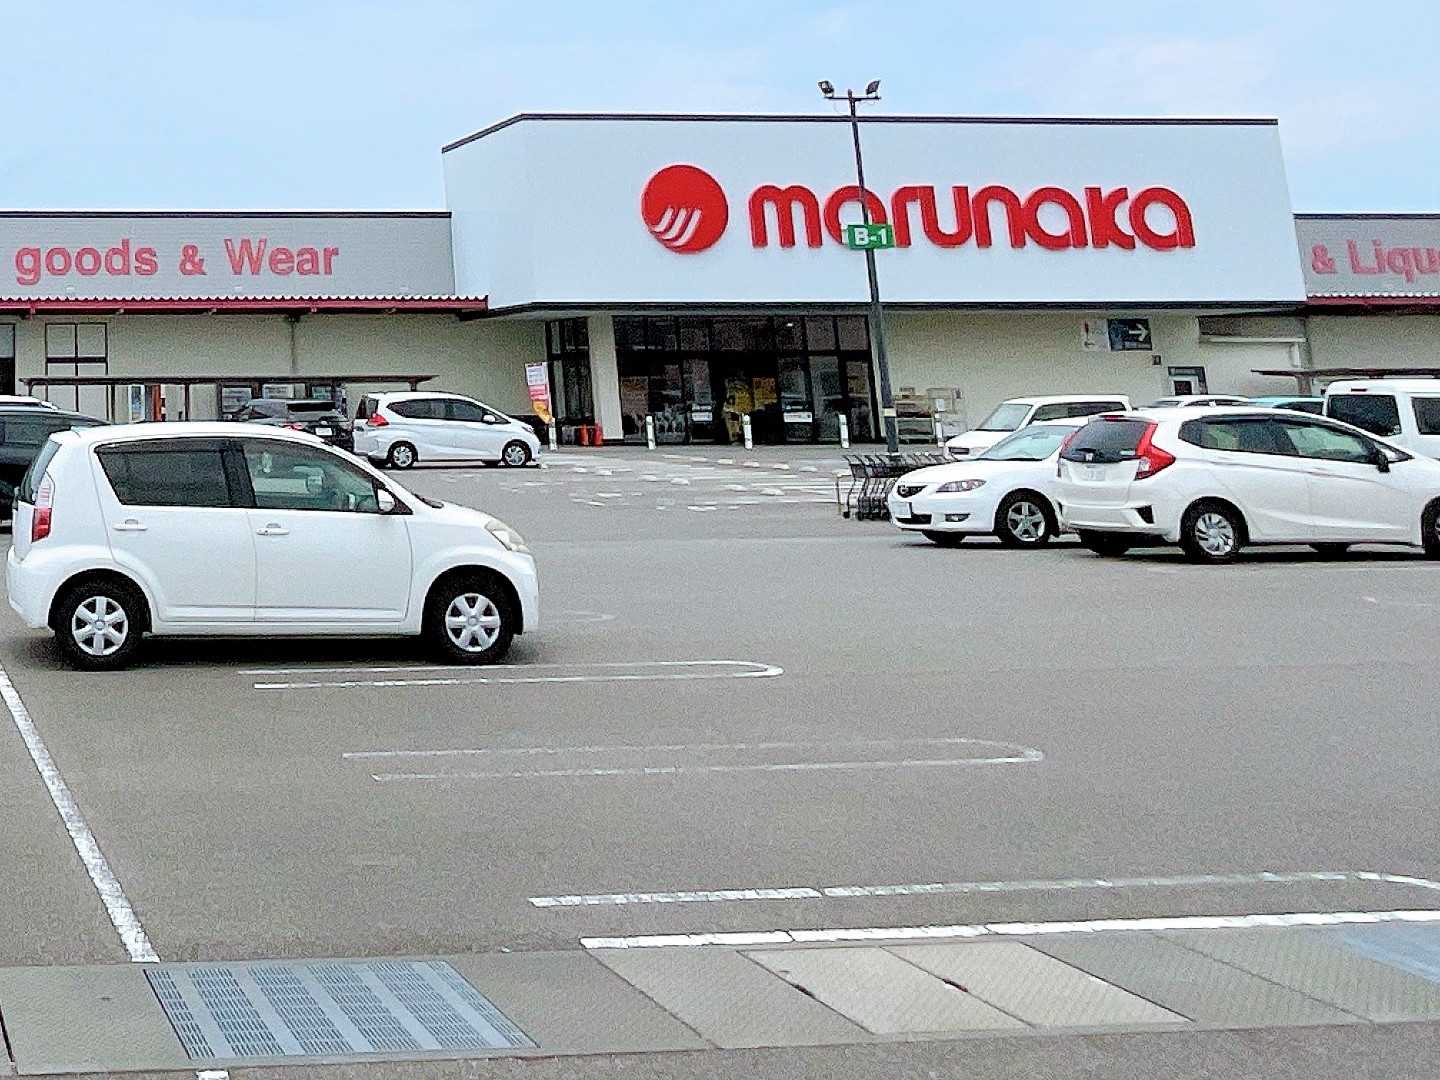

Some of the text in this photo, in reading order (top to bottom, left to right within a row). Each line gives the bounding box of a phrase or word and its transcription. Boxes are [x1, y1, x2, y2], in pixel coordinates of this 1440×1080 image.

[748, 184, 1196, 250] marunaka
[853, 227, 888, 246] B-1
[15, 239, 159, 286] goods
[179, 244, 206, 276] &
[224, 238, 339, 276] Wear
[1311, 244, 1338, 274] &
